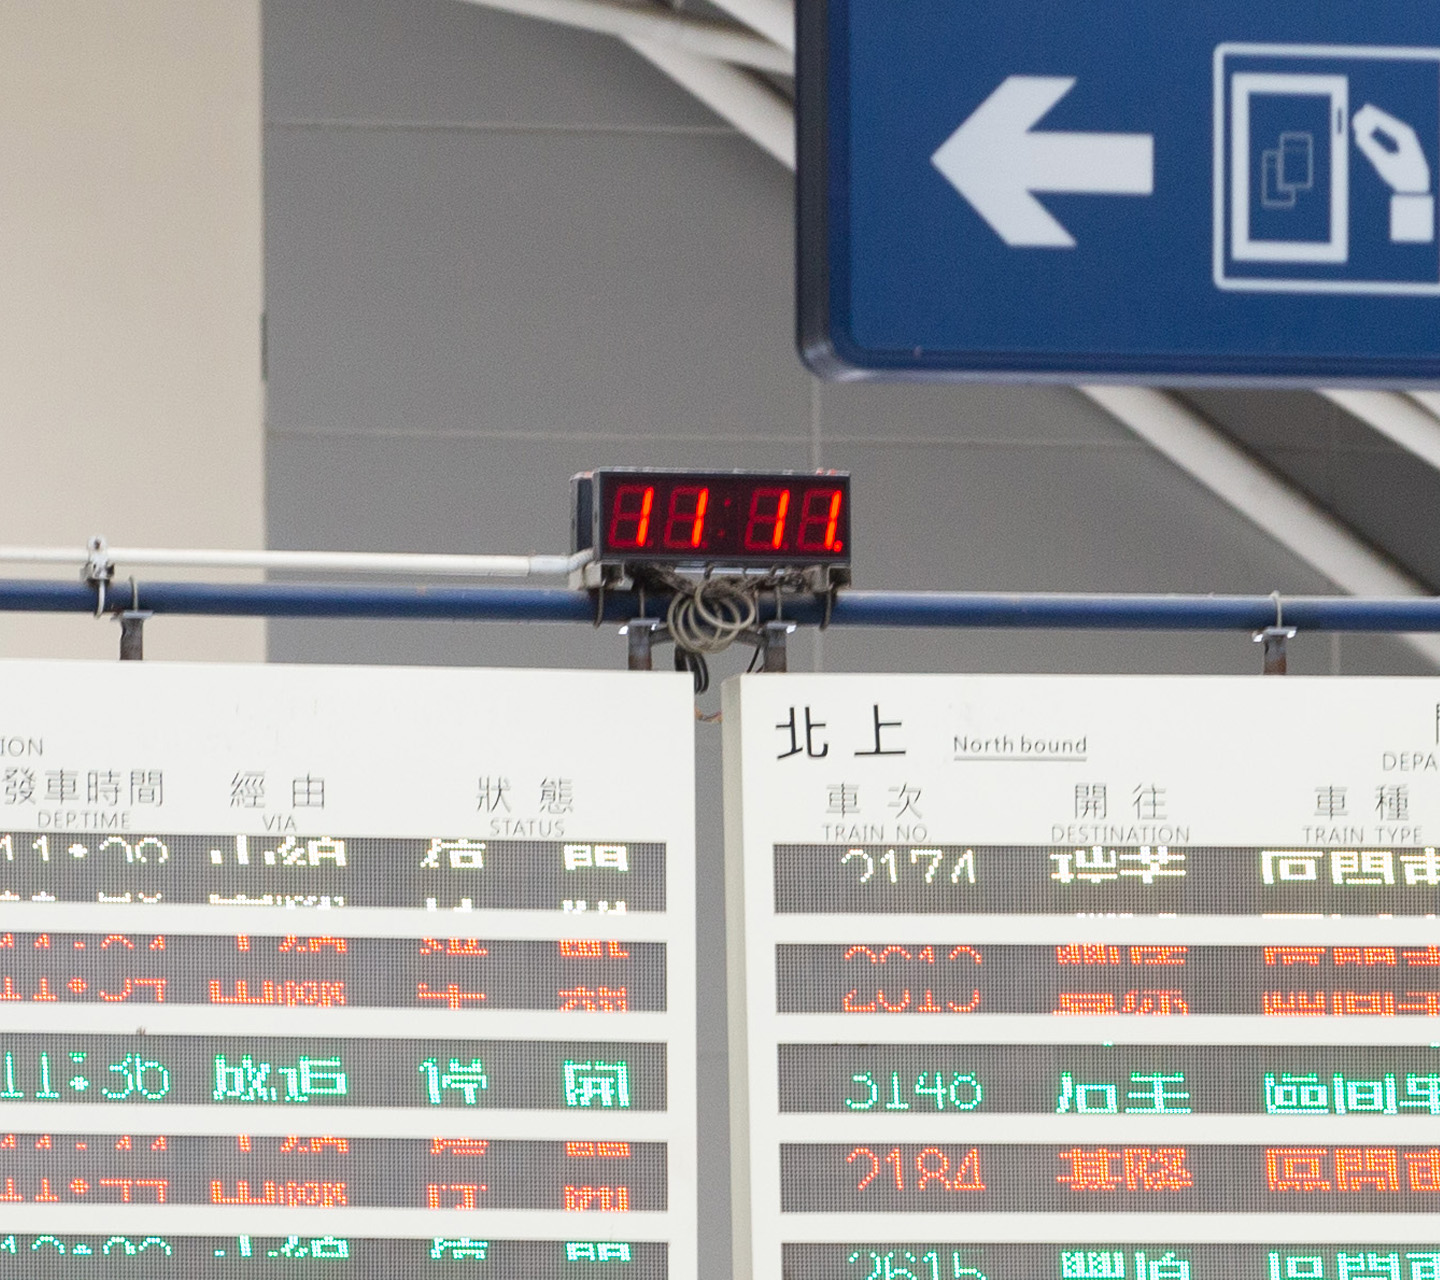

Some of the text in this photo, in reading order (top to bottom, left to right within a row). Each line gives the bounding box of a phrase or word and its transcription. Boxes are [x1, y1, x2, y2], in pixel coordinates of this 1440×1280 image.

[775, 704, 907, 760] 北上
[953, 735, 1087, 753] North bound
[5, 768, 163, 806] 發車時間
[230, 772, 325, 809] 經由
[477, 777, 573, 813] 狀態
[828, 783, 922, 818] 車次
[1074, 784, 1168, 820] 開往
[1317, 785, 1408, 820] 車種
[262, 815, 296, 831] VIA
[489, 820, 565, 838] STATUS
[822, 824, 885, 843] TRAIN
[1051, 824, 1190, 844] DESTINATION
[1302, 826, 1363, 845] TRAIN
[1374, 826, 1422, 845] TYPE
